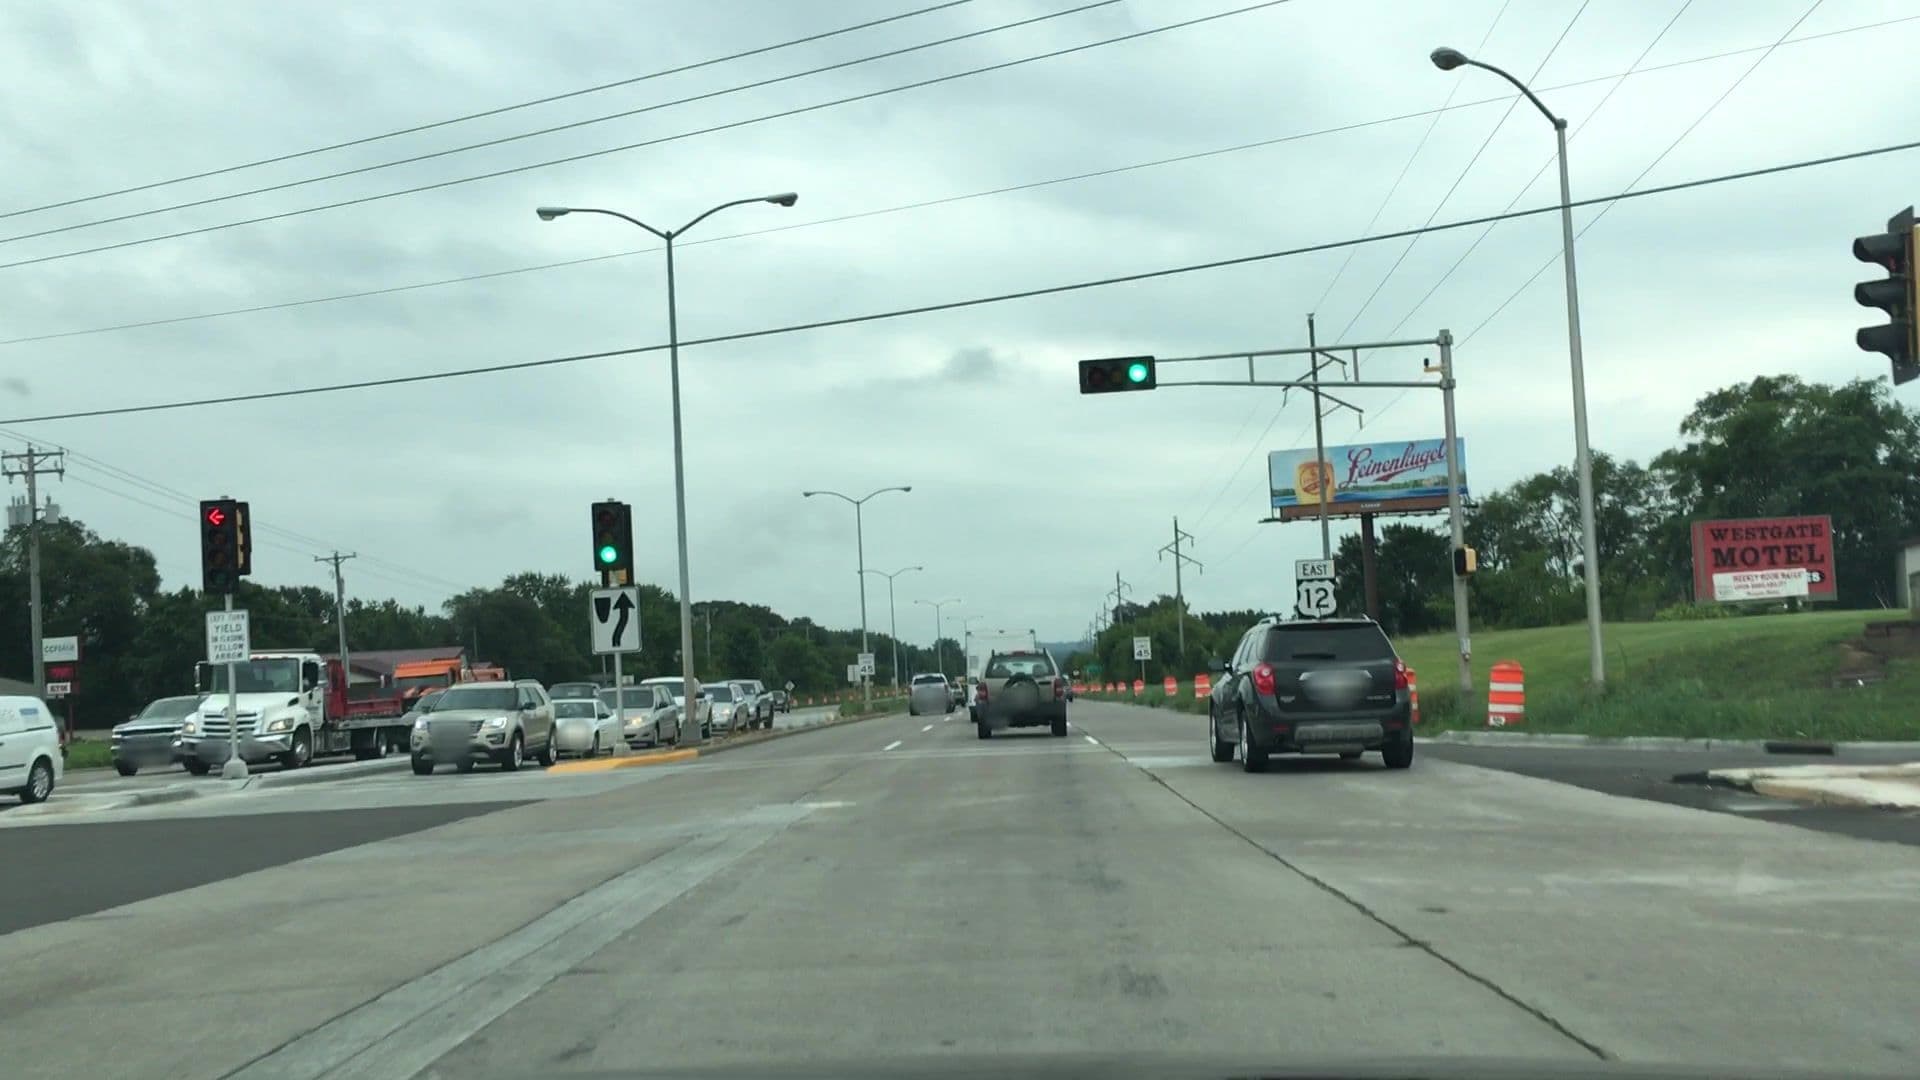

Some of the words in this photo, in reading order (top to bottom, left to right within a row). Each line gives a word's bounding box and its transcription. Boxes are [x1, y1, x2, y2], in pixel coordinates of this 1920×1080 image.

[1710, 523, 1823, 541] WESTGATE
[1711, 544, 1824, 568] MOTEL
[1302, 563, 1327, 576] EAST
[1304, 587, 1330, 609] 12
[215, 623, 242, 633] YIELD
[214, 643, 243, 651] YELLOW
[215, 652, 243, 660] ARROW
[860, 665, 873, 673] 45
